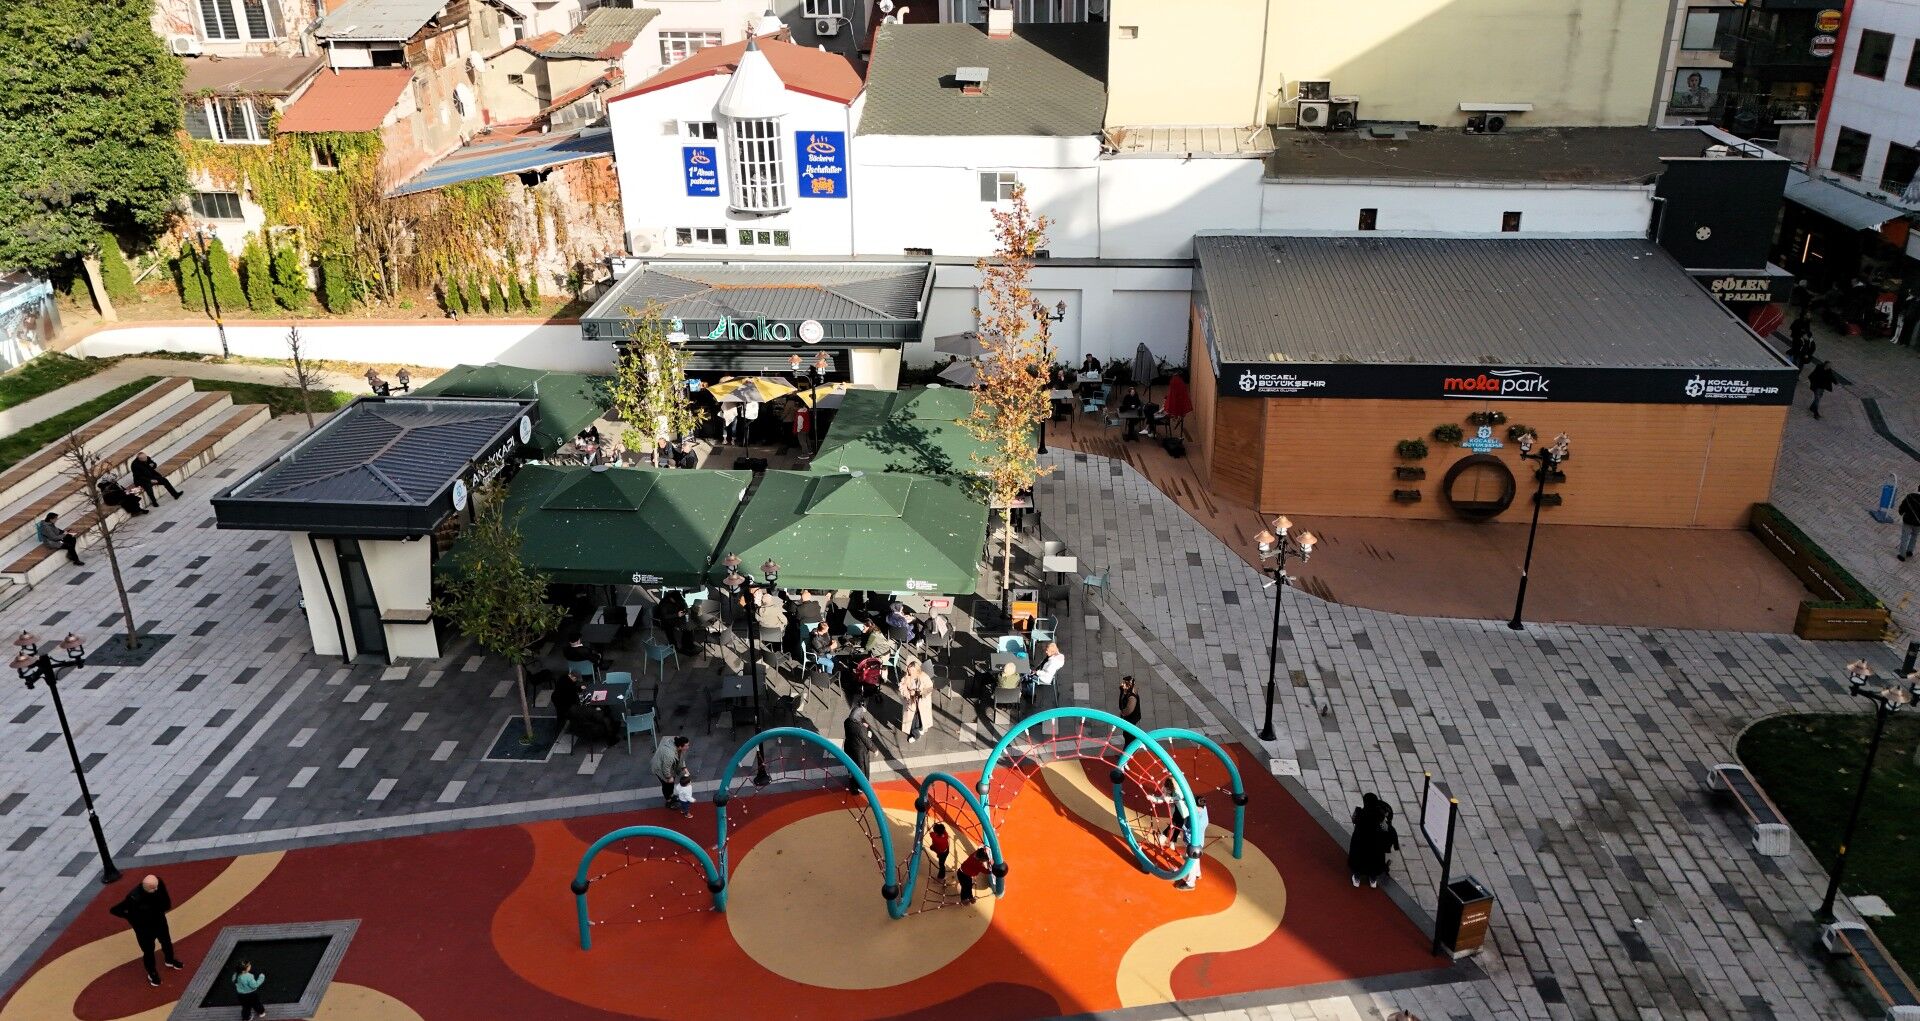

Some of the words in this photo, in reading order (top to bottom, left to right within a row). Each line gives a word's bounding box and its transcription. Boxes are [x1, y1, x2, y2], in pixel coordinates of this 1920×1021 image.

[1711, 277, 1770, 292] ŞÖLEN
[1724, 293, 1771, 301] PAZARI
[727, 315, 791, 341] halka
